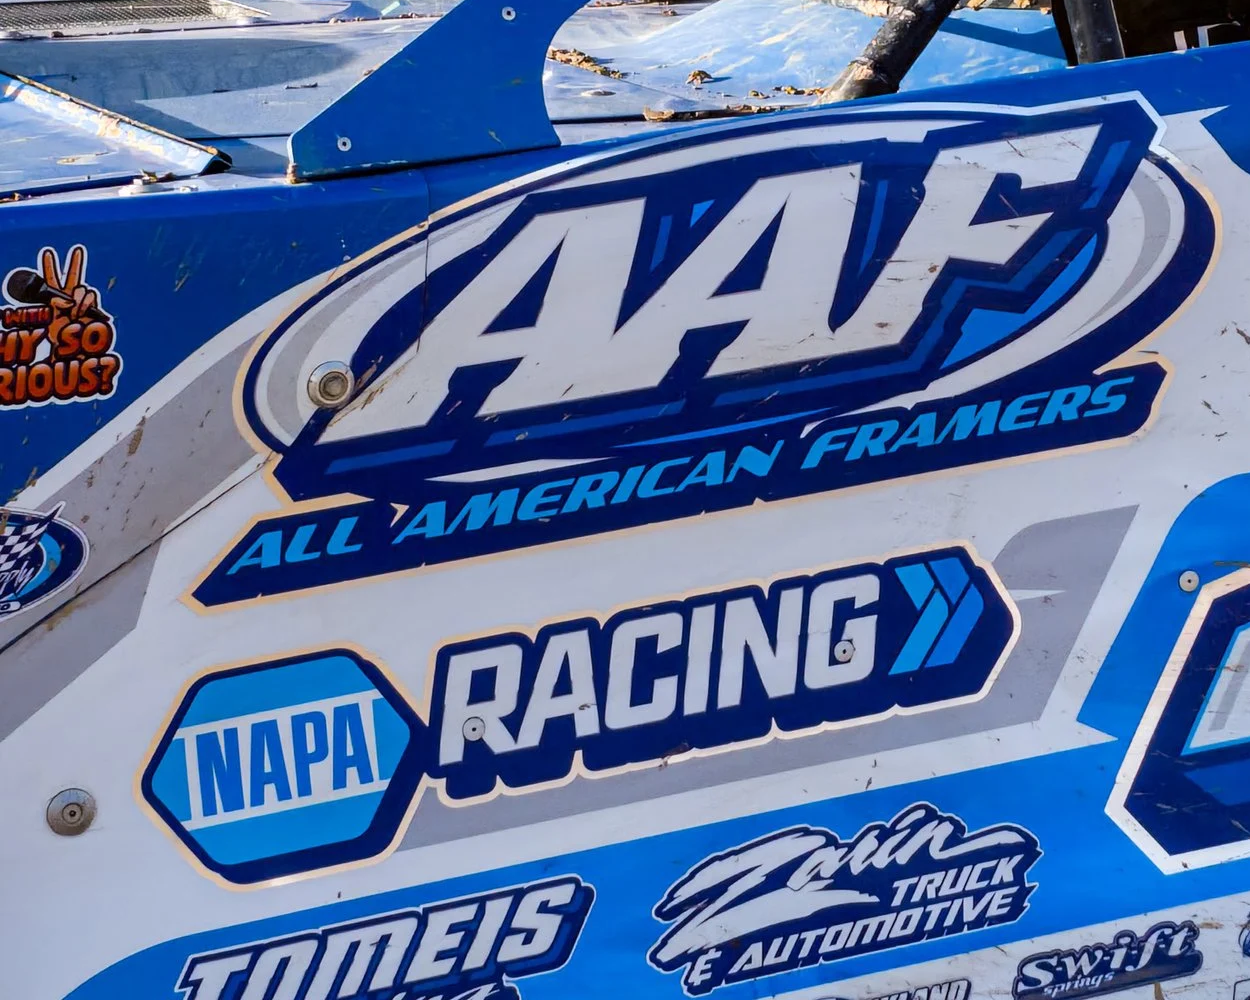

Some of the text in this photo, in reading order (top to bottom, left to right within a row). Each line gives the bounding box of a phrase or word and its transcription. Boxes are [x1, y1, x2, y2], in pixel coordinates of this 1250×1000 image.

[315, 122, 1107, 445] AAF
[57, 321, 109, 356] SO
[226, 375, 1134, 576] ALL AMERICAN FRAMERS
[439, 573, 882, 766] RACING
[196, 702, 375, 817] NAPA
[656, 807, 1026, 963] Zarin
[891, 852, 1024, 908] TRUCK
[731, 887, 1014, 975] AUTOMOTIVE
[1018, 925, 1194, 993] Swift
[1043, 971, 1116, 998] springs
